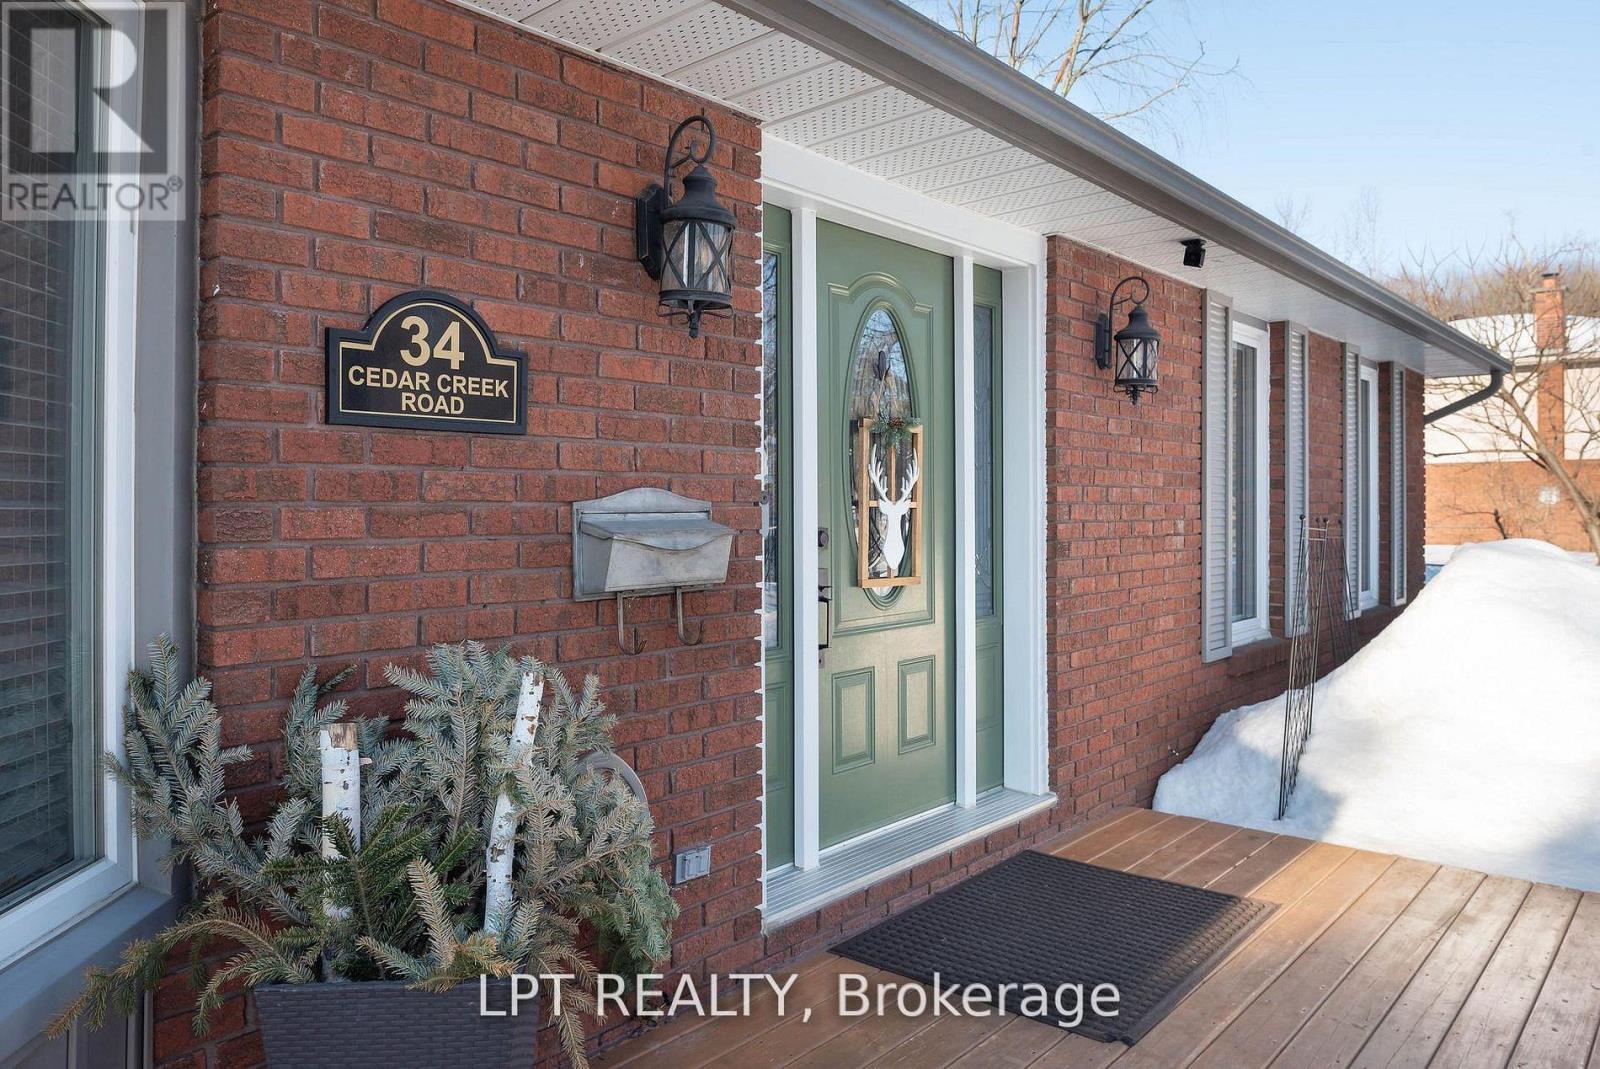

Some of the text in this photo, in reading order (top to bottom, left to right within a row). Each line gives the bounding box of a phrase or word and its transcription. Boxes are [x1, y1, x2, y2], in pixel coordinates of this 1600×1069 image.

[400, 315, 465, 370] 34
[348, 365, 509, 398] CEDAR CREEK
[401, 392, 465, 415] ROAD
